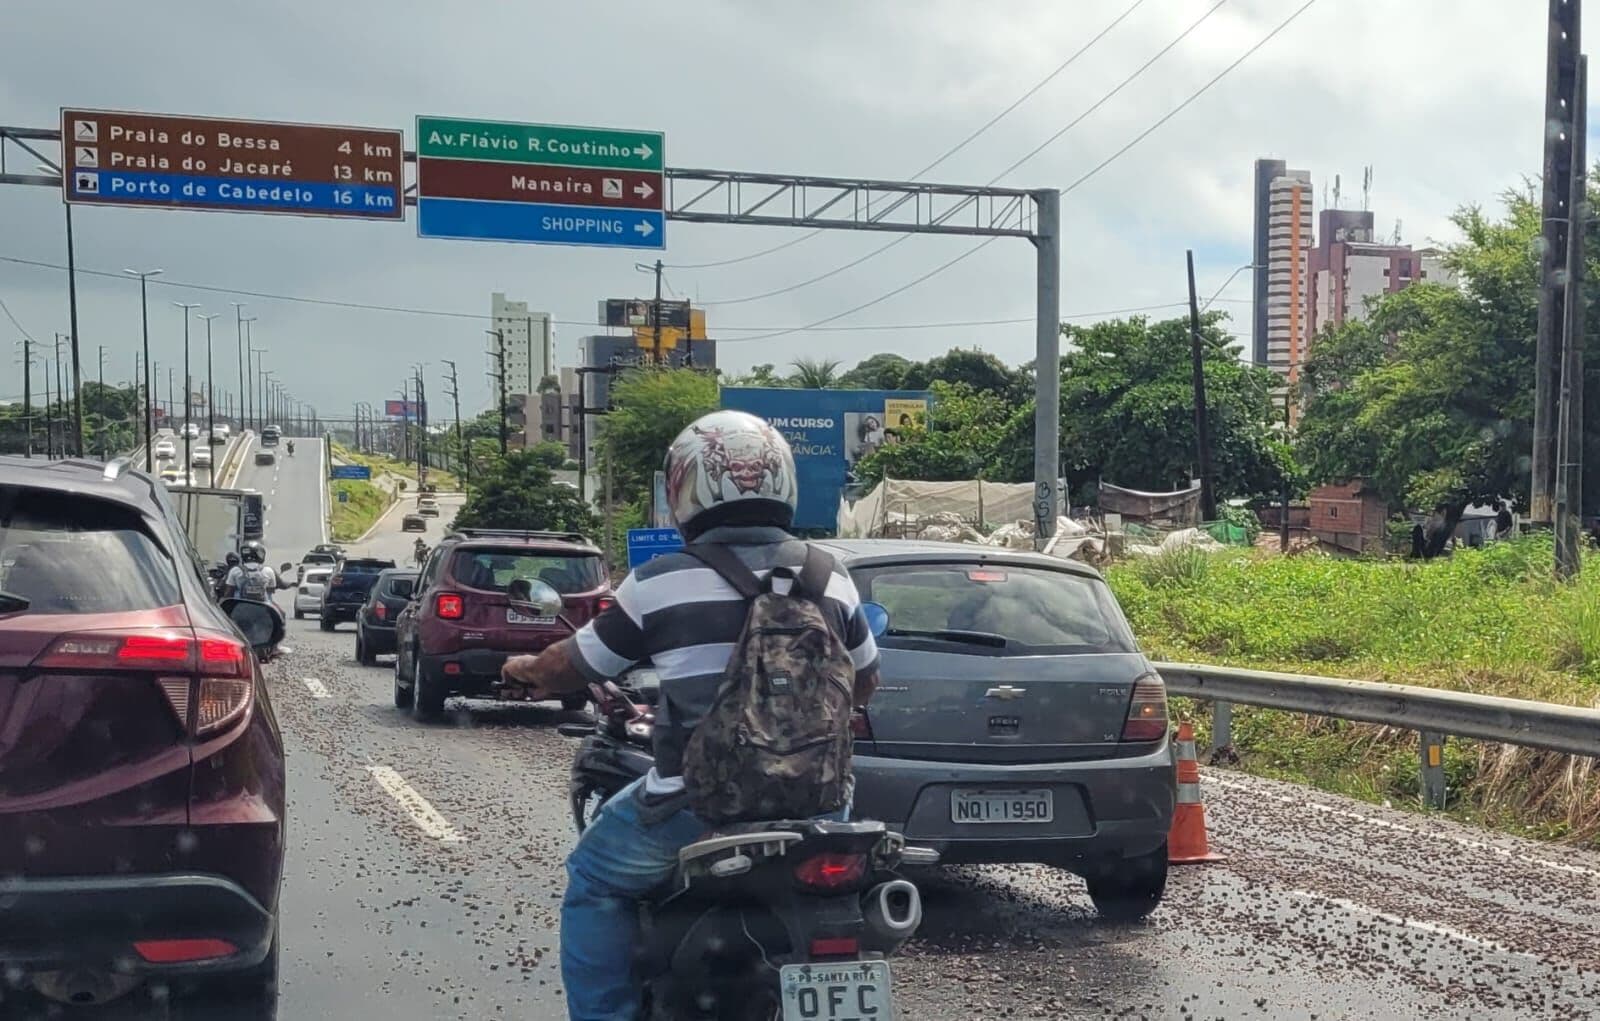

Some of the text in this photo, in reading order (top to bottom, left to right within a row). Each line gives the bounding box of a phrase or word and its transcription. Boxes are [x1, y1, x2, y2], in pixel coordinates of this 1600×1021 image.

[110, 125, 392, 158] Praia do Bessa 4 km
[111, 152, 393, 182] Praia do Jacaré 13 km
[111, 177, 393, 207] Porto de Cabedelo 16 km
[542, 216, 623, 234] SHOPPING
[790, 417, 834, 429] CURSO
[798, 985, 878, 1018] OFC
